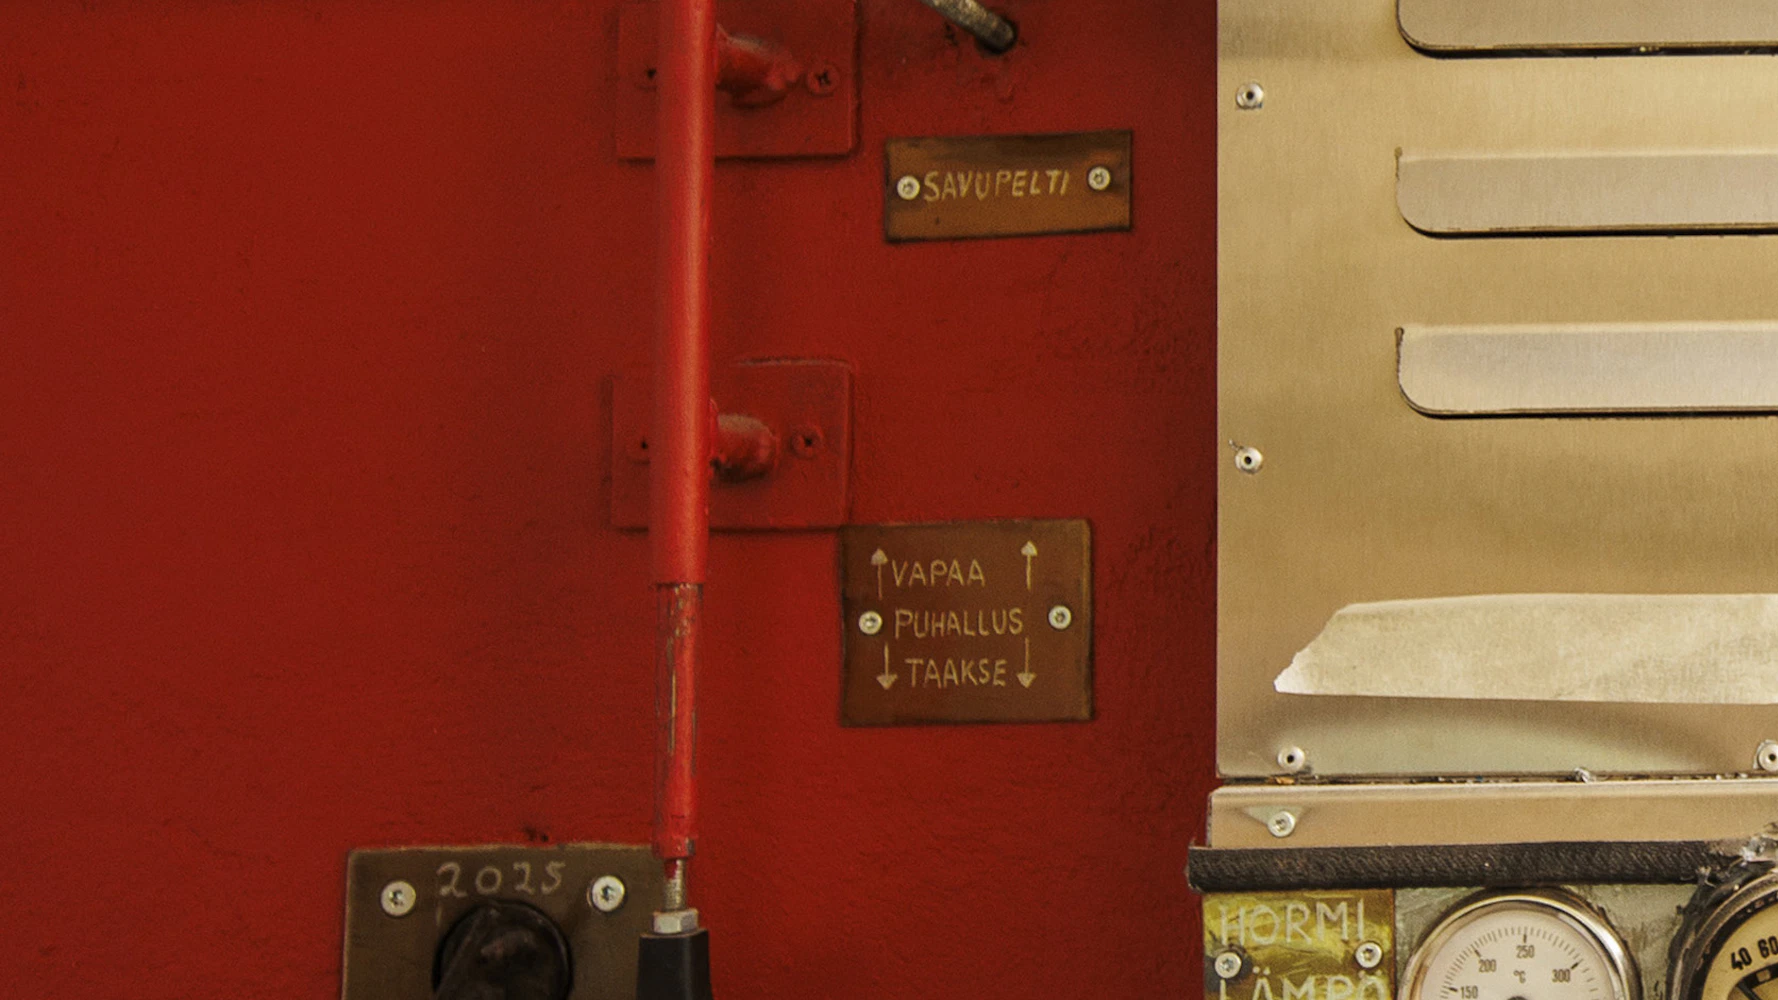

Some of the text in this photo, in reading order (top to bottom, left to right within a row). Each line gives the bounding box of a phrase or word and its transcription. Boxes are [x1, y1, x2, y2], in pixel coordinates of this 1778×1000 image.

[923, 168, 1070, 201] SAVUPELTI
[891, 559, 985, 587] VAPAA
[895, 607, 1024, 638] PUHALLUS
[905, 657, 1008, 687] TAAKSE
[436, 861, 566, 898] 2025
[1220, 898, 1365, 945] HORMI
[1516, 945, 1535, 958] 250
[1730, 947, 1753, 971] 40
[1478, 959, 1497, 973] 200
[1552, 968, 1571, 983] 300
[1460, 985, 1479, 999] 150
